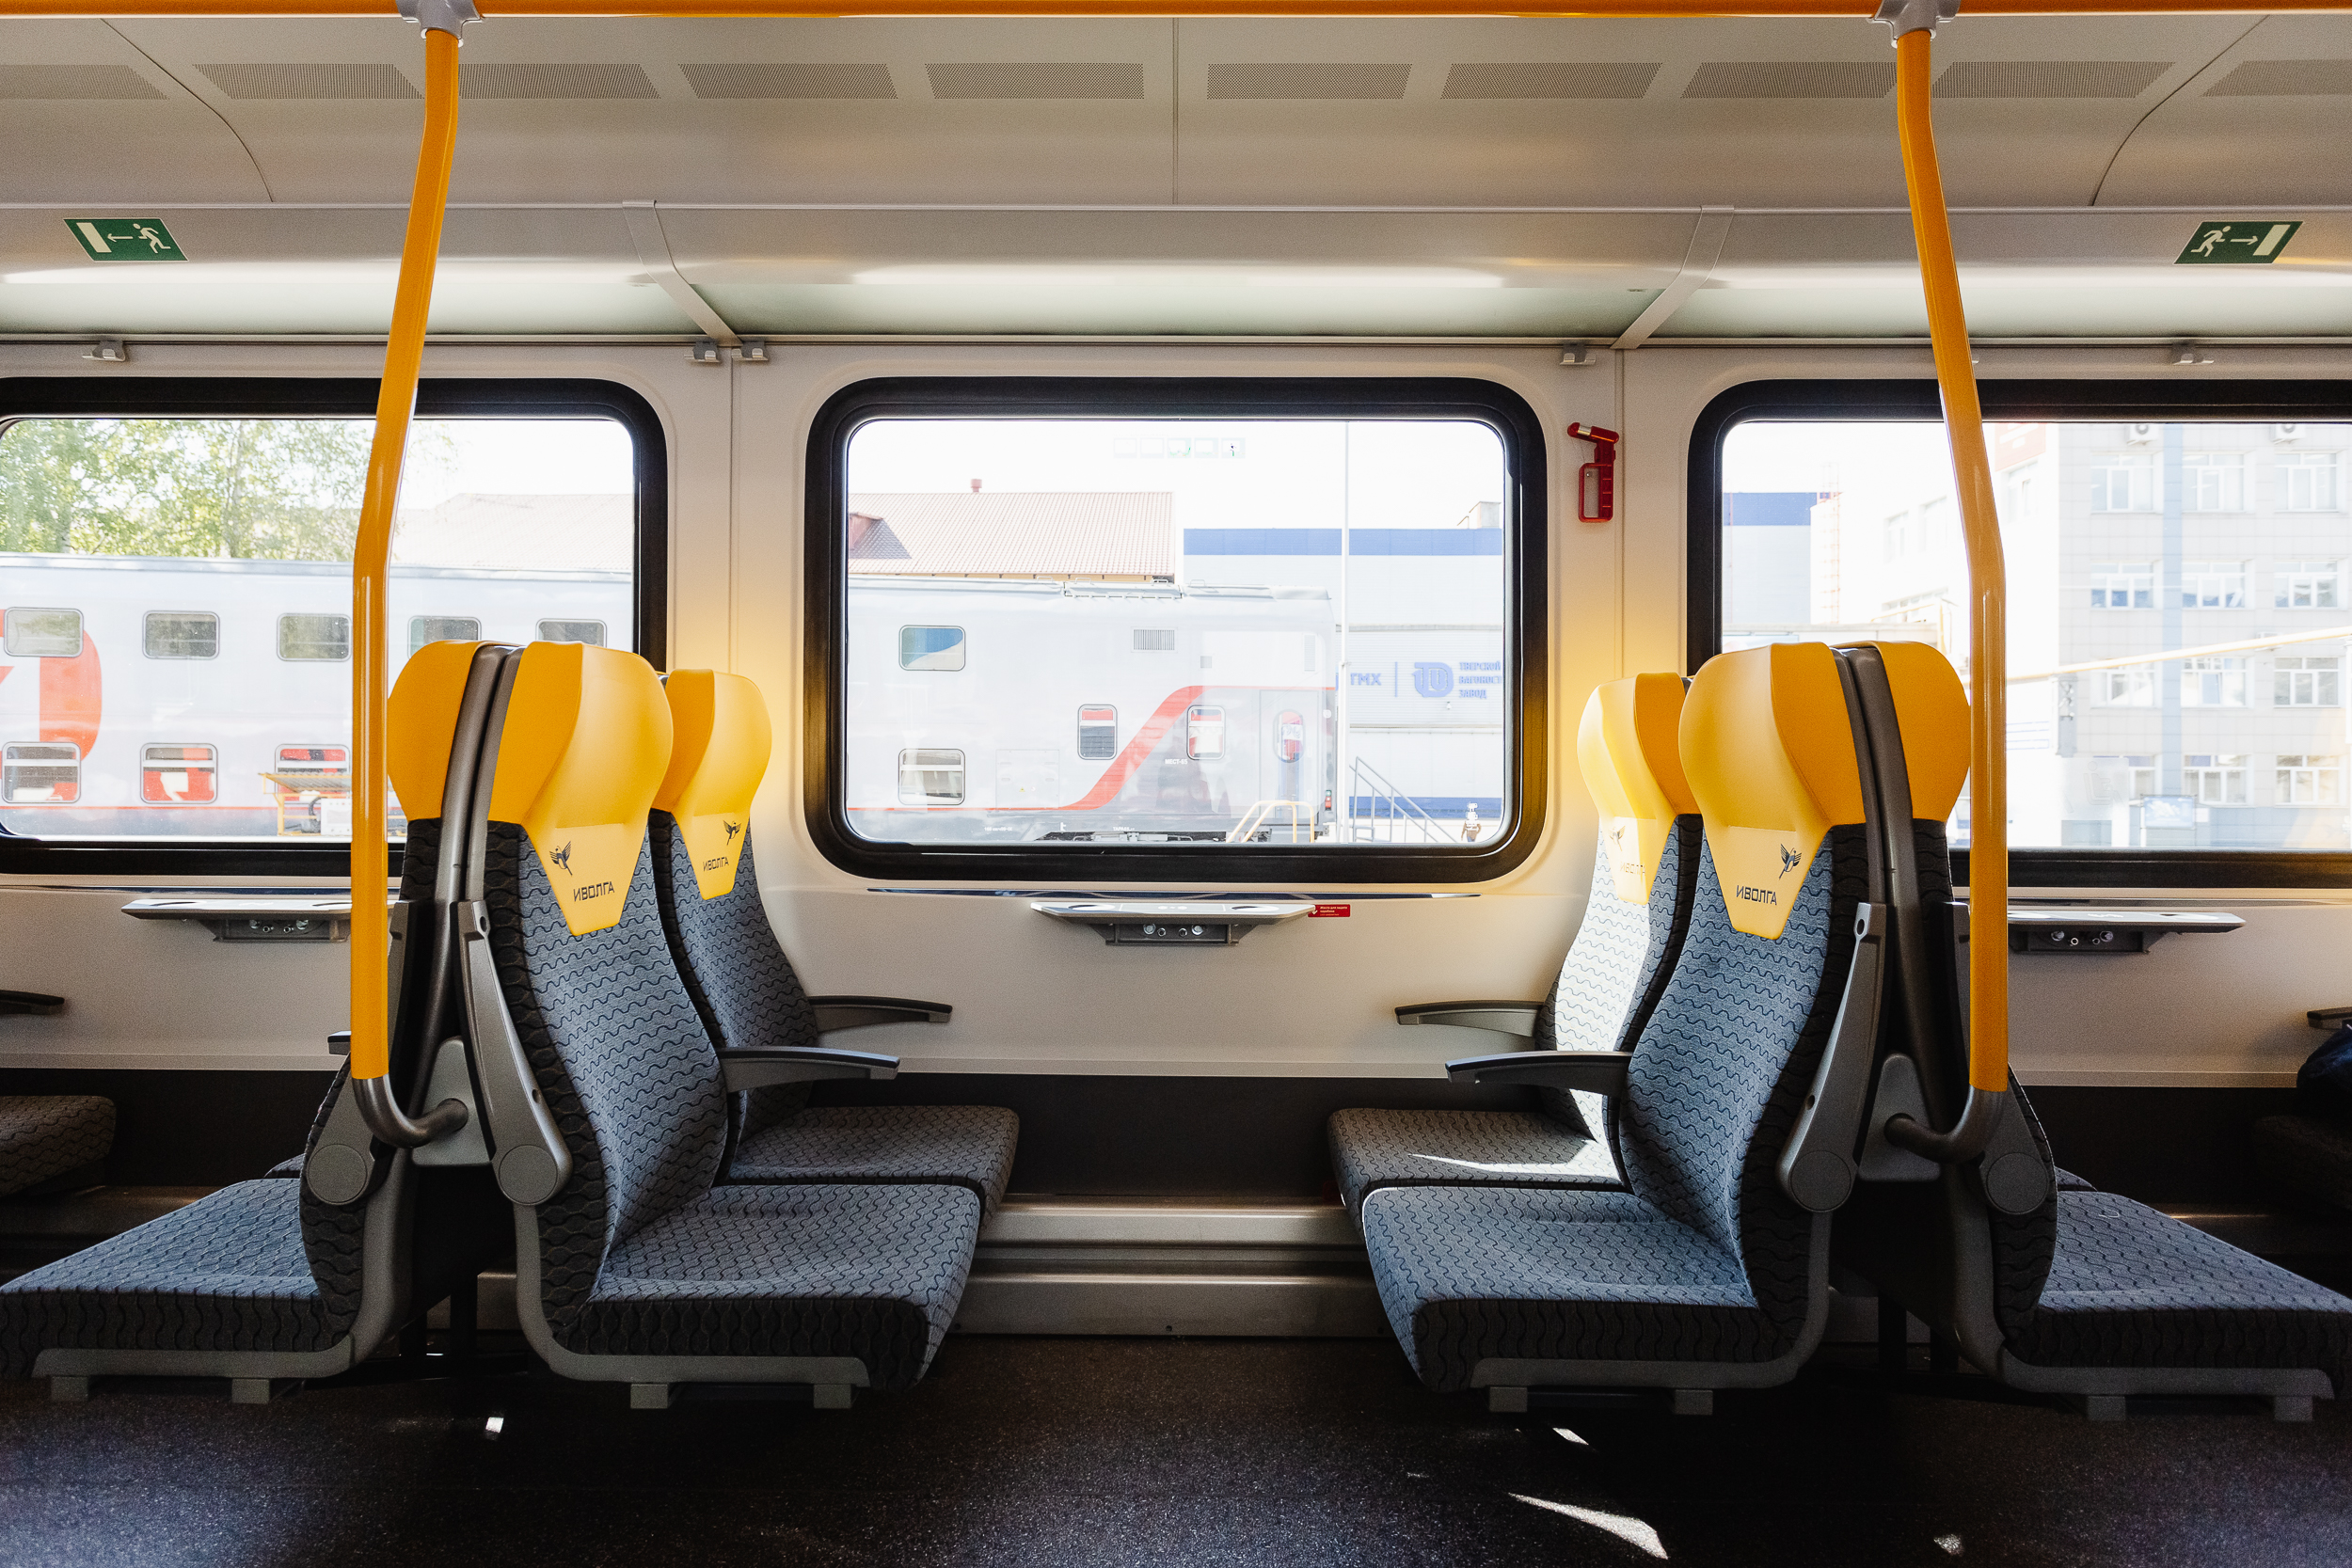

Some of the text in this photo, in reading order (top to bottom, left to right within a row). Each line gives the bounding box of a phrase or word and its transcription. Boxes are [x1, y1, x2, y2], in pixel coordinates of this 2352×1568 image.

[1459, 660, 1502, 671] ТВЕРСКОЙ
[1459, 689, 1487, 699] ЗАВОД
[703, 856, 729, 872] ИВОЛГА
[573, 880, 615, 902] ИВОЛГА
[1736, 884, 1777, 906] ИВОЛГА
